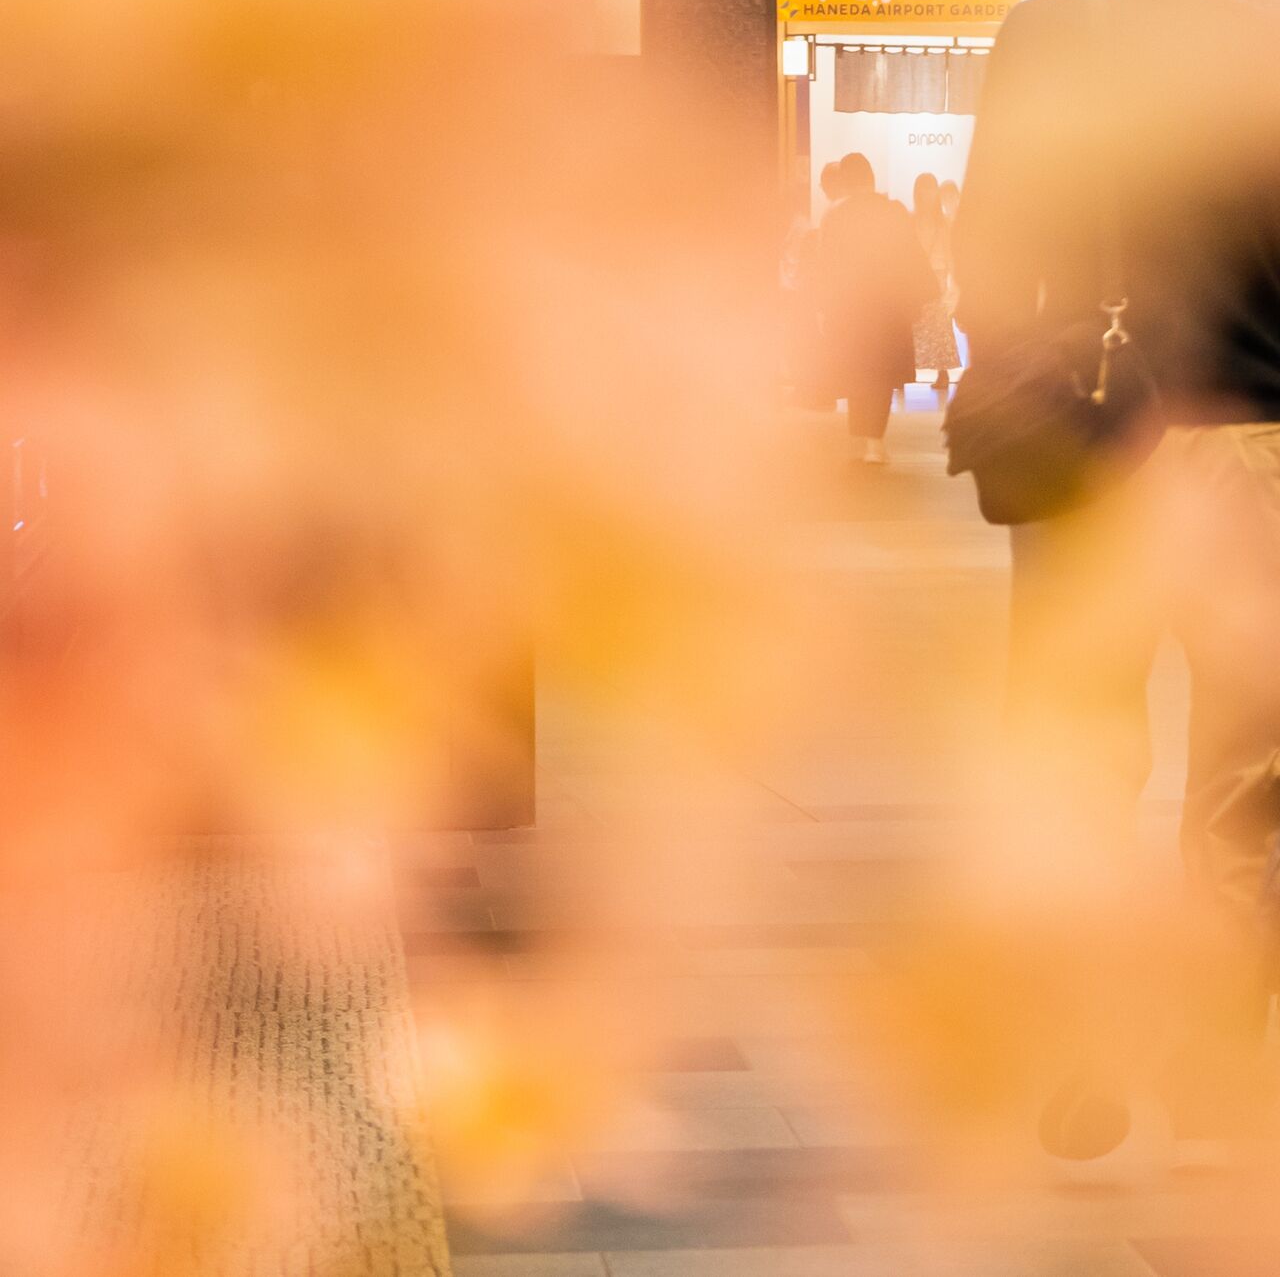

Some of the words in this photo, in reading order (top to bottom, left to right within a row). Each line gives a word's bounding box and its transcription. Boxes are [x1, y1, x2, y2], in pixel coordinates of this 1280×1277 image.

[803, 3, 871, 16] HANEDA
[877, 3, 945, 16] AIRPORT
[951, 3, 1012, 16] GARDE
